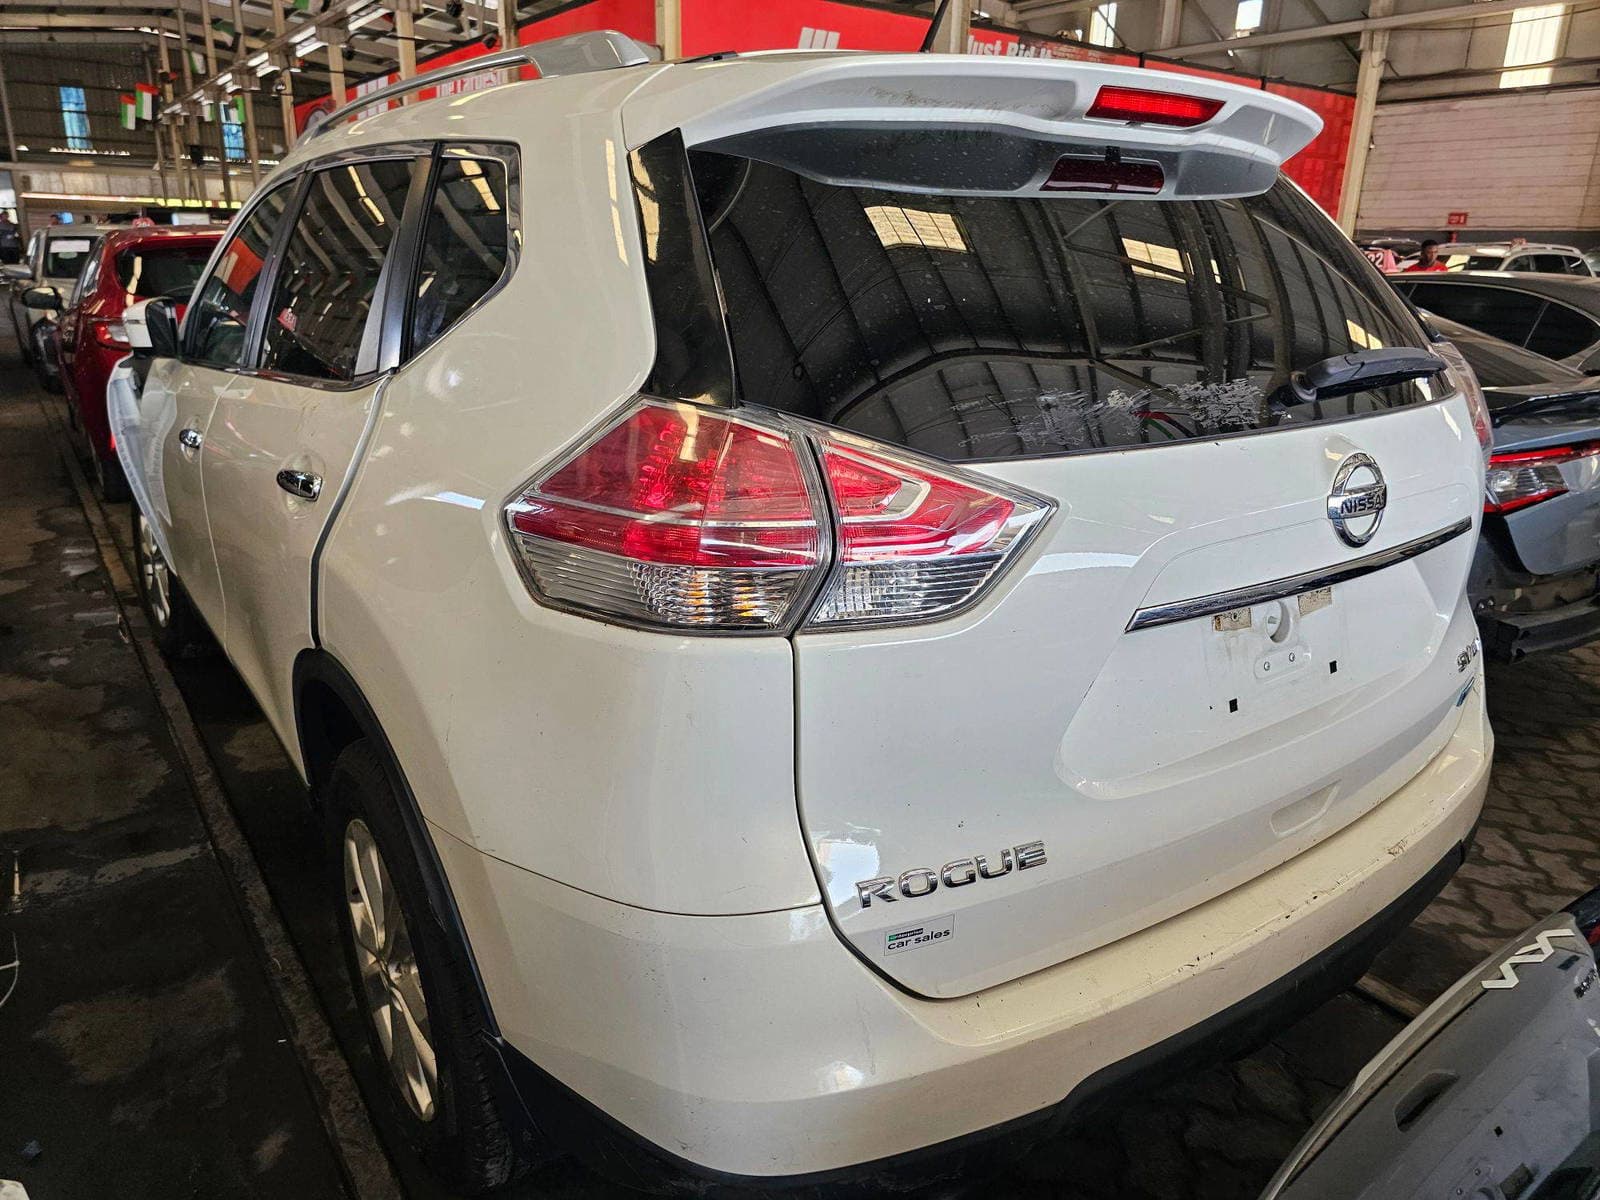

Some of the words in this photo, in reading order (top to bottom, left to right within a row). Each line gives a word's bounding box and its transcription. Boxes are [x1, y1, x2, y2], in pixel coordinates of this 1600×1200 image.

[855, 840, 1048, 908] ROGUE
[888, 939, 911, 950] car
[914, 929, 950, 944] sales
